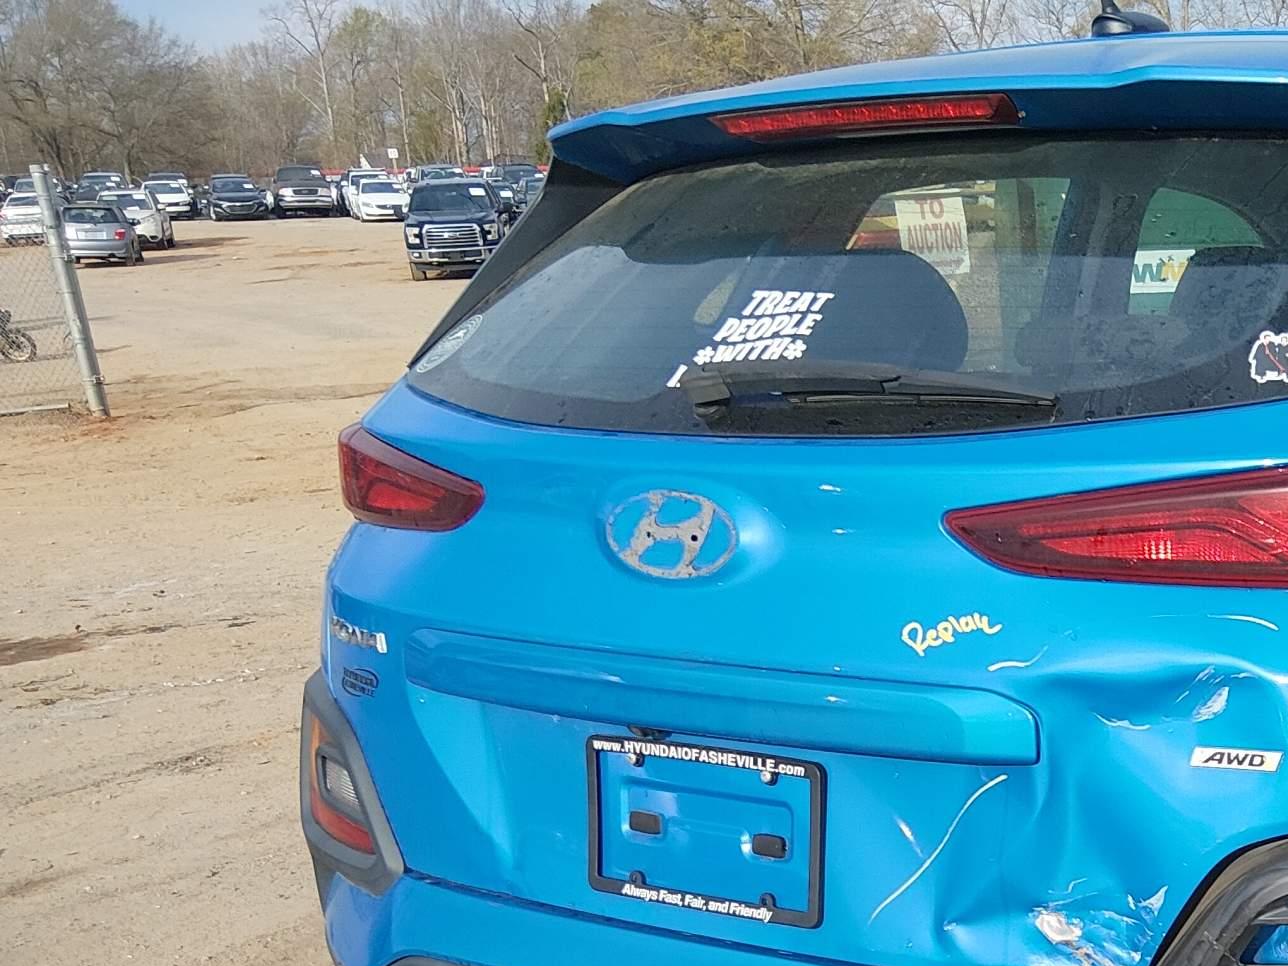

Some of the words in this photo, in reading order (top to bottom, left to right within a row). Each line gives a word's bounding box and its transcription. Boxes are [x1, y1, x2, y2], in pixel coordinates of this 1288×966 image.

[915, 198, 944, 220] TO
[907, 221, 963, 254] AUCTION
[741, 290, 835, 316] TREAT
[712, 313, 823, 342] PEOPLE
[592, 739, 806, 777] www.HYUNDAIOFASHEVILLE.com
[1202, 751, 1265, 767] AWD
[621, 883, 659, 903] Always
[658, 889, 683, 908] Fast,
[684, 894, 707, 912] Fair,
[707, 900, 730, 914] and
[729, 902, 773, 924] Friendly
